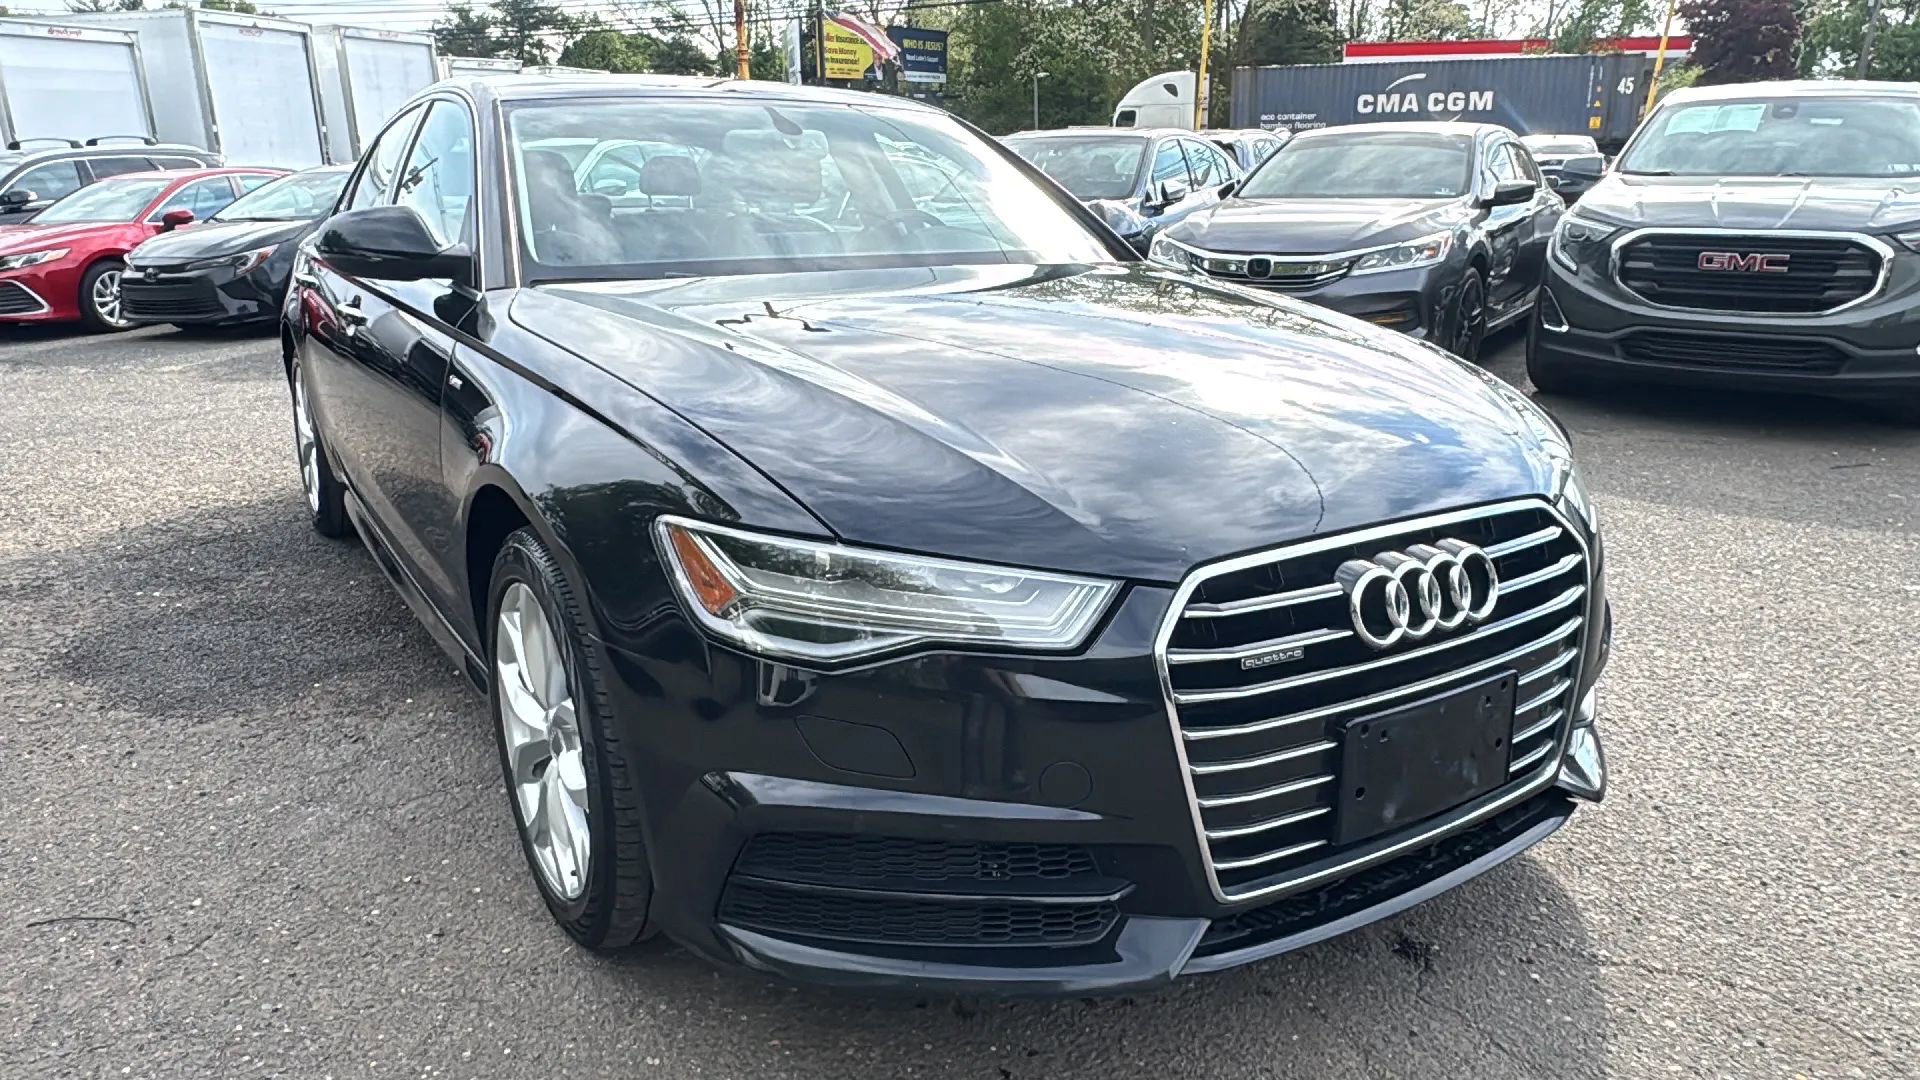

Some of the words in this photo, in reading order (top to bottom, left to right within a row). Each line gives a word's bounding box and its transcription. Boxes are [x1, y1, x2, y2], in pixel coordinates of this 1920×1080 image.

[903, 38, 917, 48] WHO
[917, 40, 924, 49] IS
[924, 41, 944, 51] JESUS?
[1617, 77, 1635, 94] 45
[1357, 93, 1419, 114] CMA
[1427, 91, 1494, 112] CGM
[1277, 111, 1317, 121] container
[1294, 121, 1327, 129] flooring
[1698, 251, 1791, 273] GMC
[1244, 649, 1302, 669] quattro
